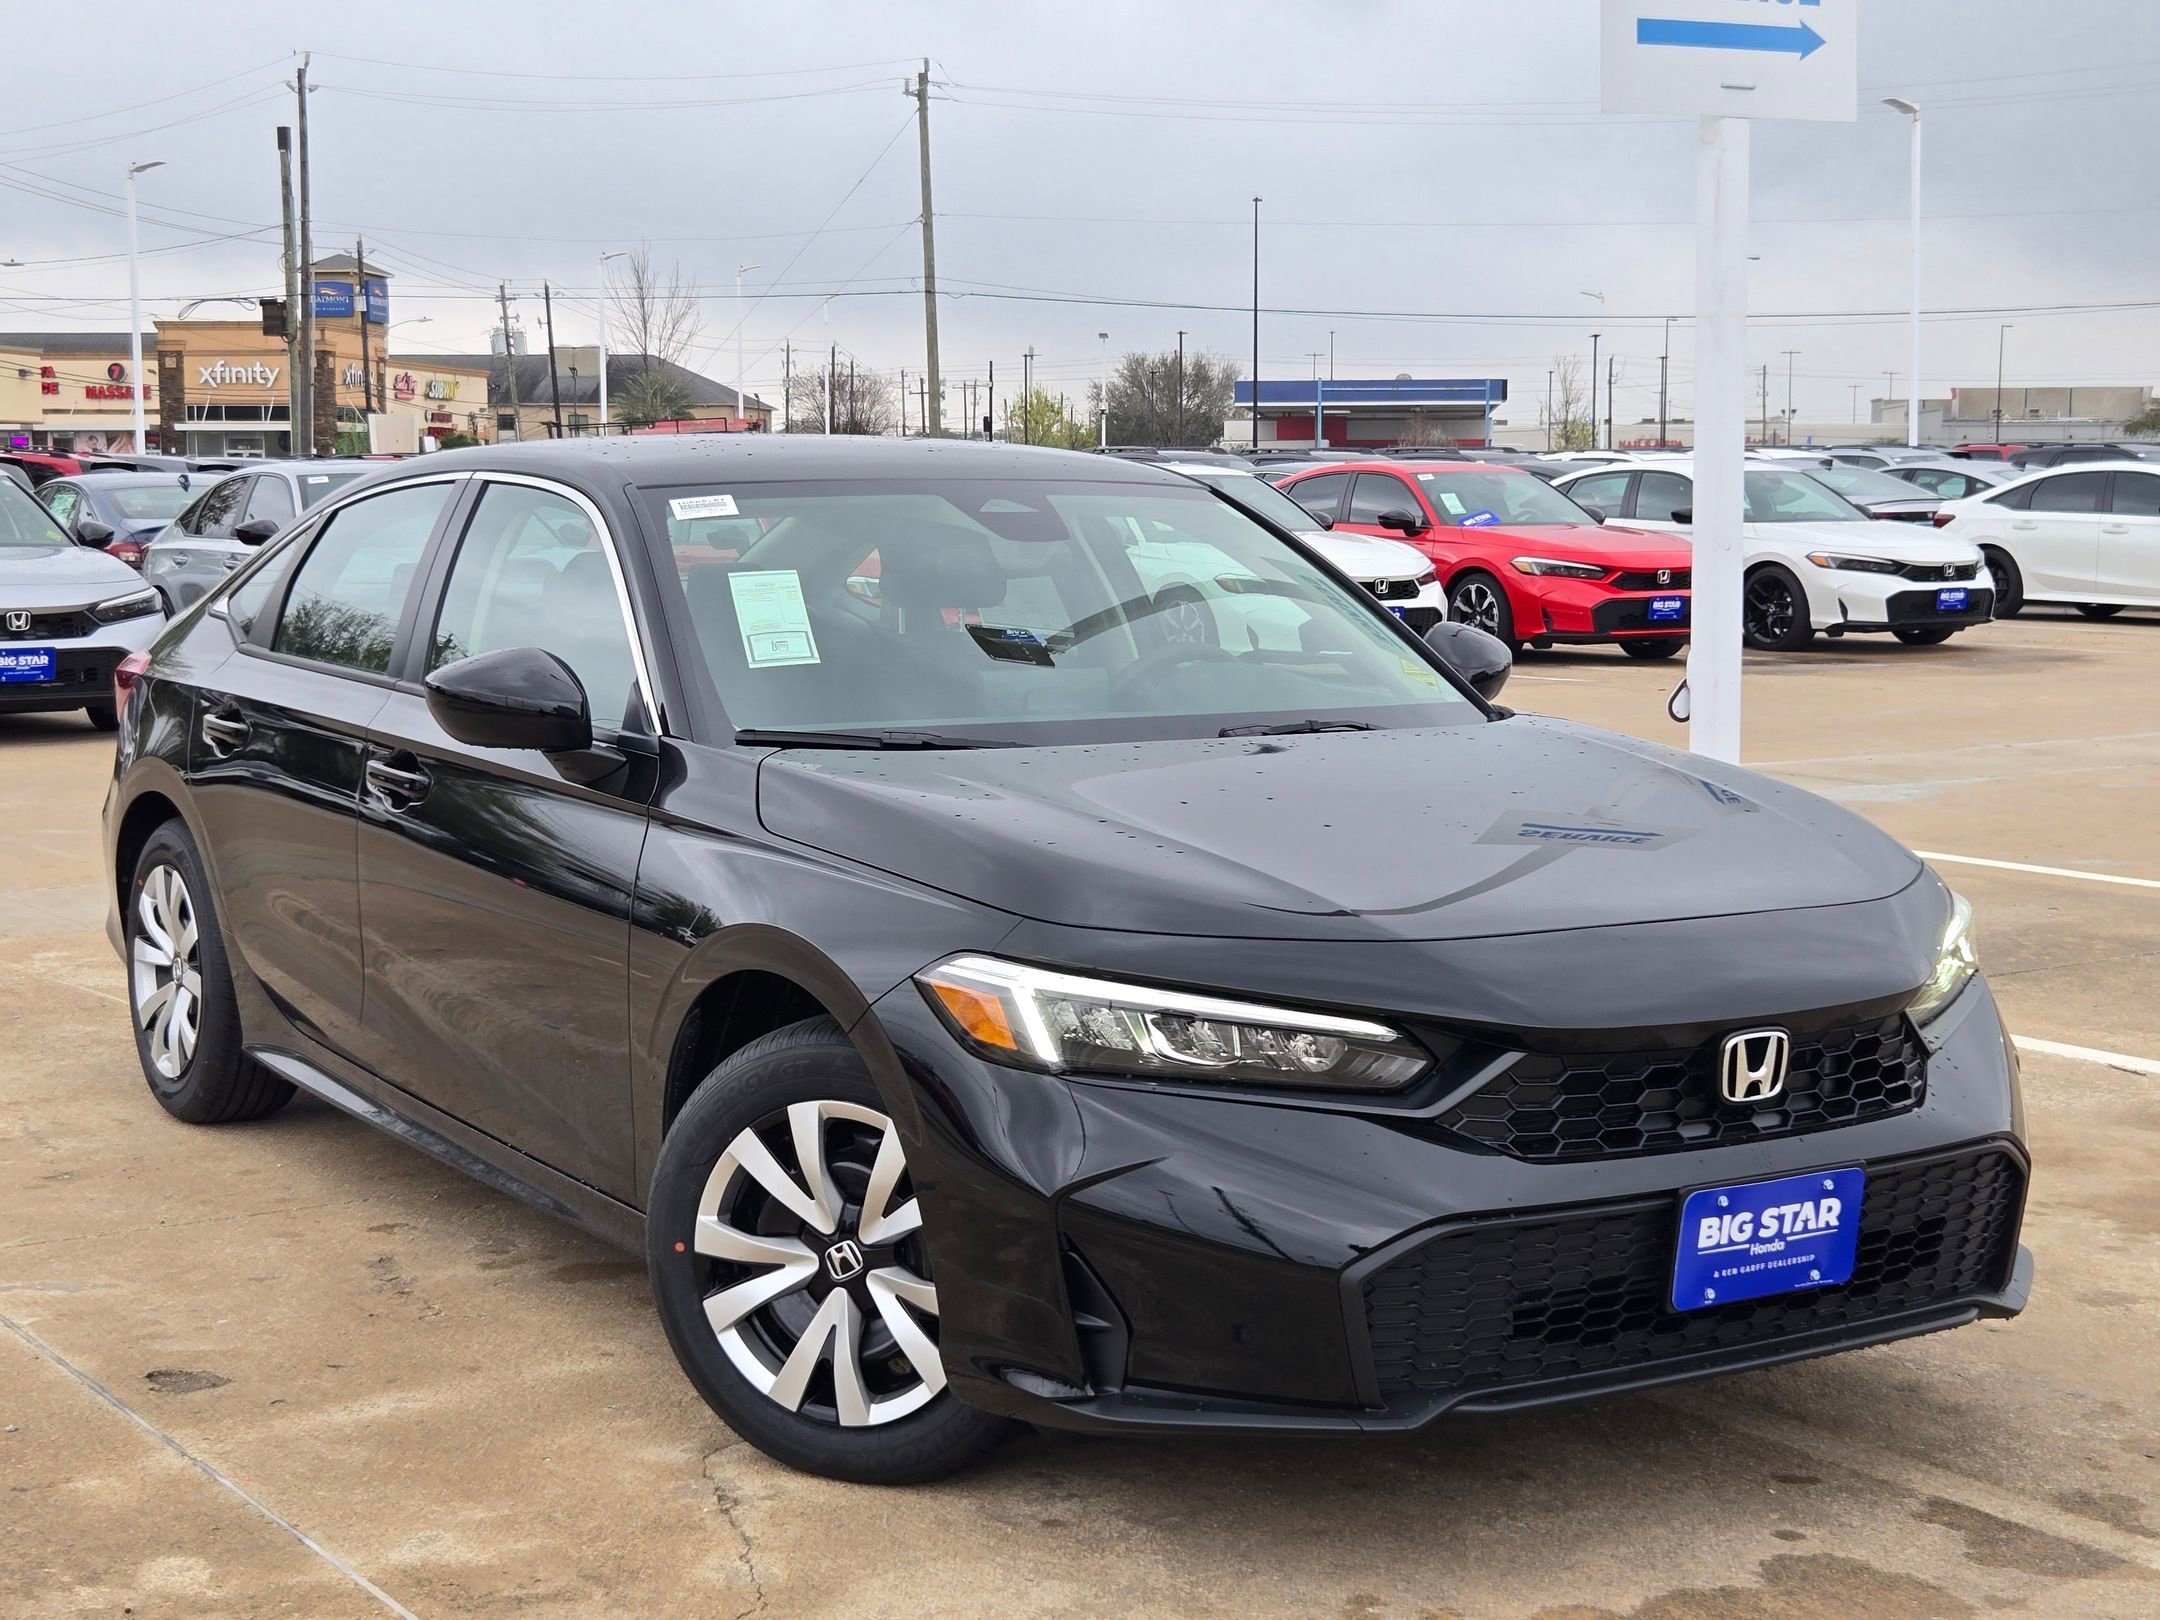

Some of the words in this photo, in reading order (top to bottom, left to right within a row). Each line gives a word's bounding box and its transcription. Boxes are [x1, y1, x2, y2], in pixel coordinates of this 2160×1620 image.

[199, 360, 280, 388] xfinity
[86, 386, 152, 400] MASSAE
[428, 380, 459, 399] SUBWAY
[0, 656, 17, 666] BIG
[18, 655, 49, 666] STAR
[1697, 1212, 1754, 1248] BIG
[1758, 1197, 1842, 1238] STAR
[1750, 1239, 1785, 1256] Honda
[1767, 1254, 1815, 1269] DEALERSHIP
